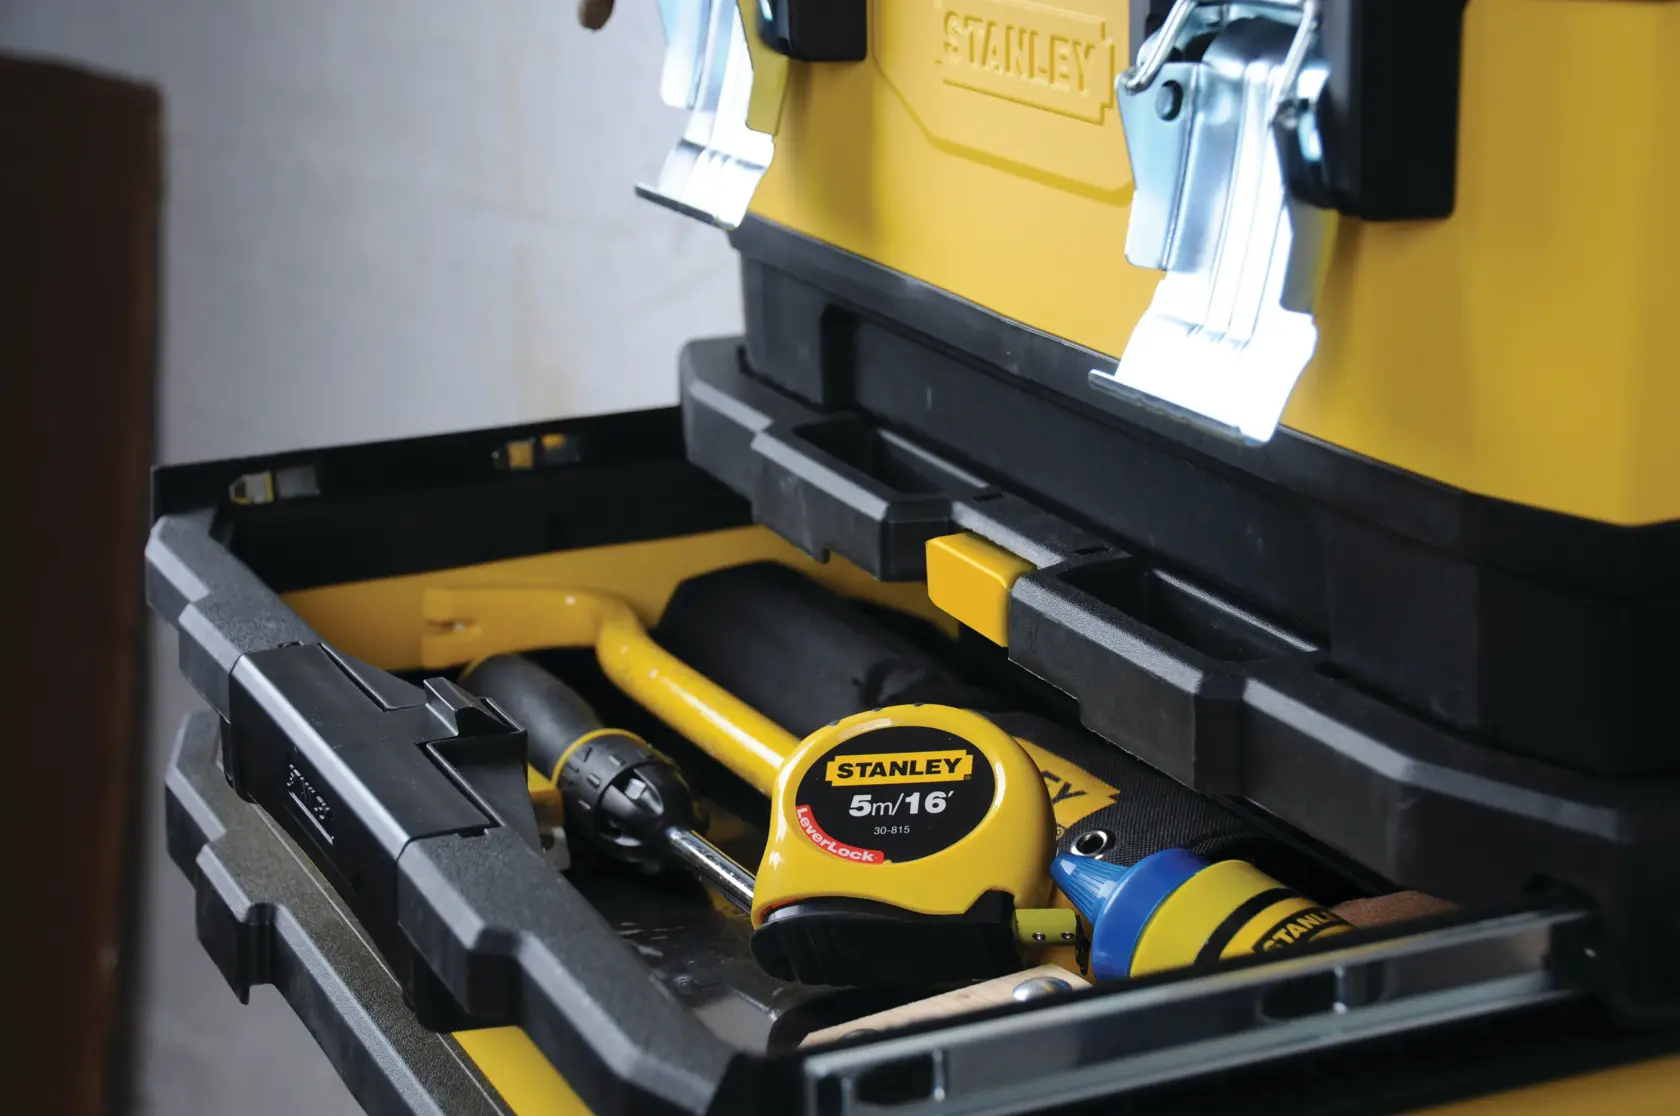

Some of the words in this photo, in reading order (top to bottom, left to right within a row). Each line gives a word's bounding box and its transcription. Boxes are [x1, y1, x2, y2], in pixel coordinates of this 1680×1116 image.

[941, 9, 1096, 97] STANLEY
[836, 757, 962, 779] STANLEY
[796, 807, 875, 862] LeverLock
[873, 825, 910, 835] 30-815
